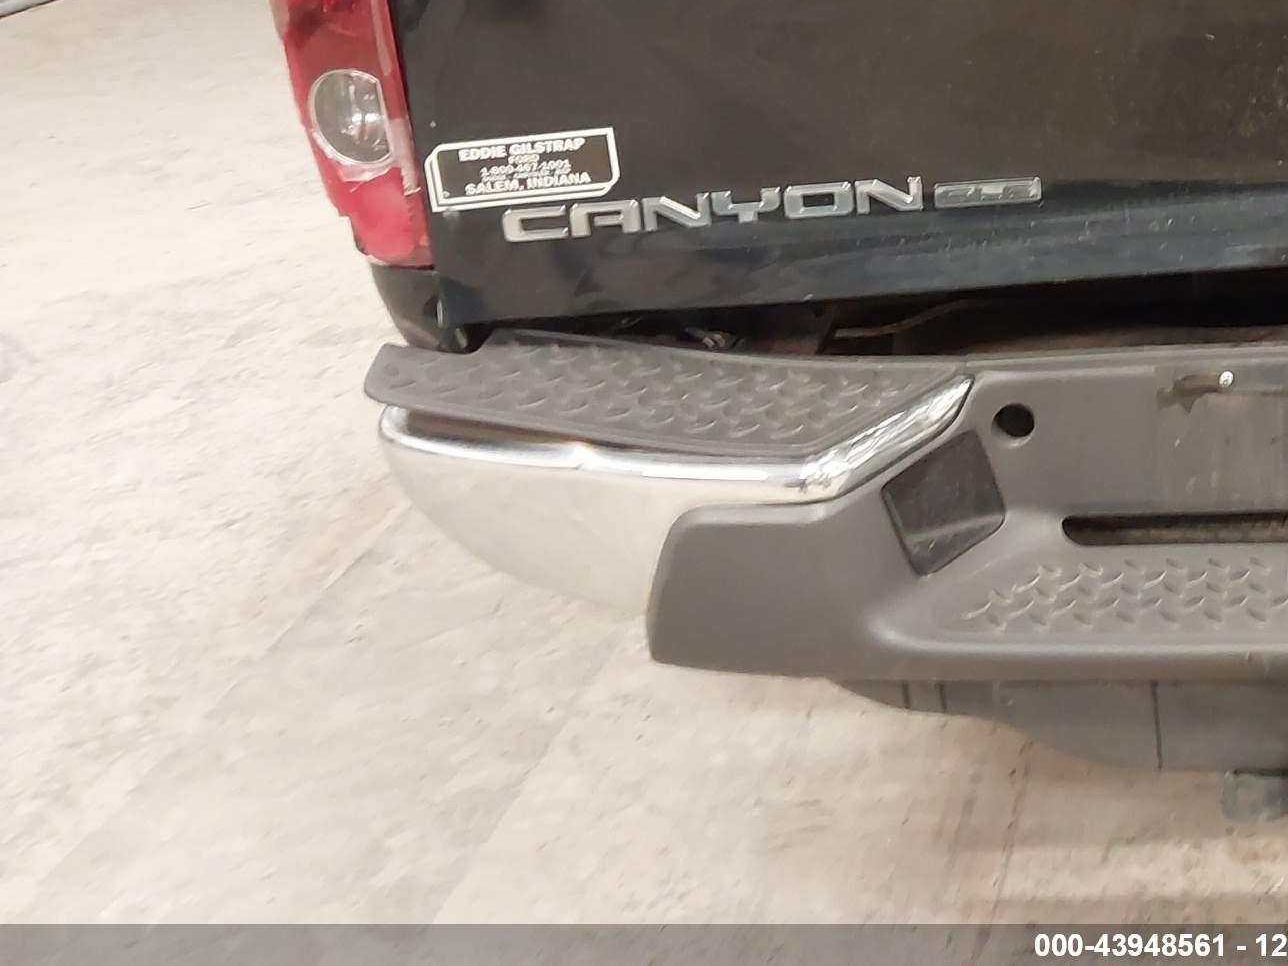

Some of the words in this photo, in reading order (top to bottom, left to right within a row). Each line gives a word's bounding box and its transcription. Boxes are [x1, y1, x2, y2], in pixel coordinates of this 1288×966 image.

[458, 146, 507, 162] EDDIE
[509, 138, 585, 154] GILSTRAP
[465, 180, 524, 195] SALEM,
[526, 172, 591, 189] INDIANA
[502, 178, 923, 242] CANYON
